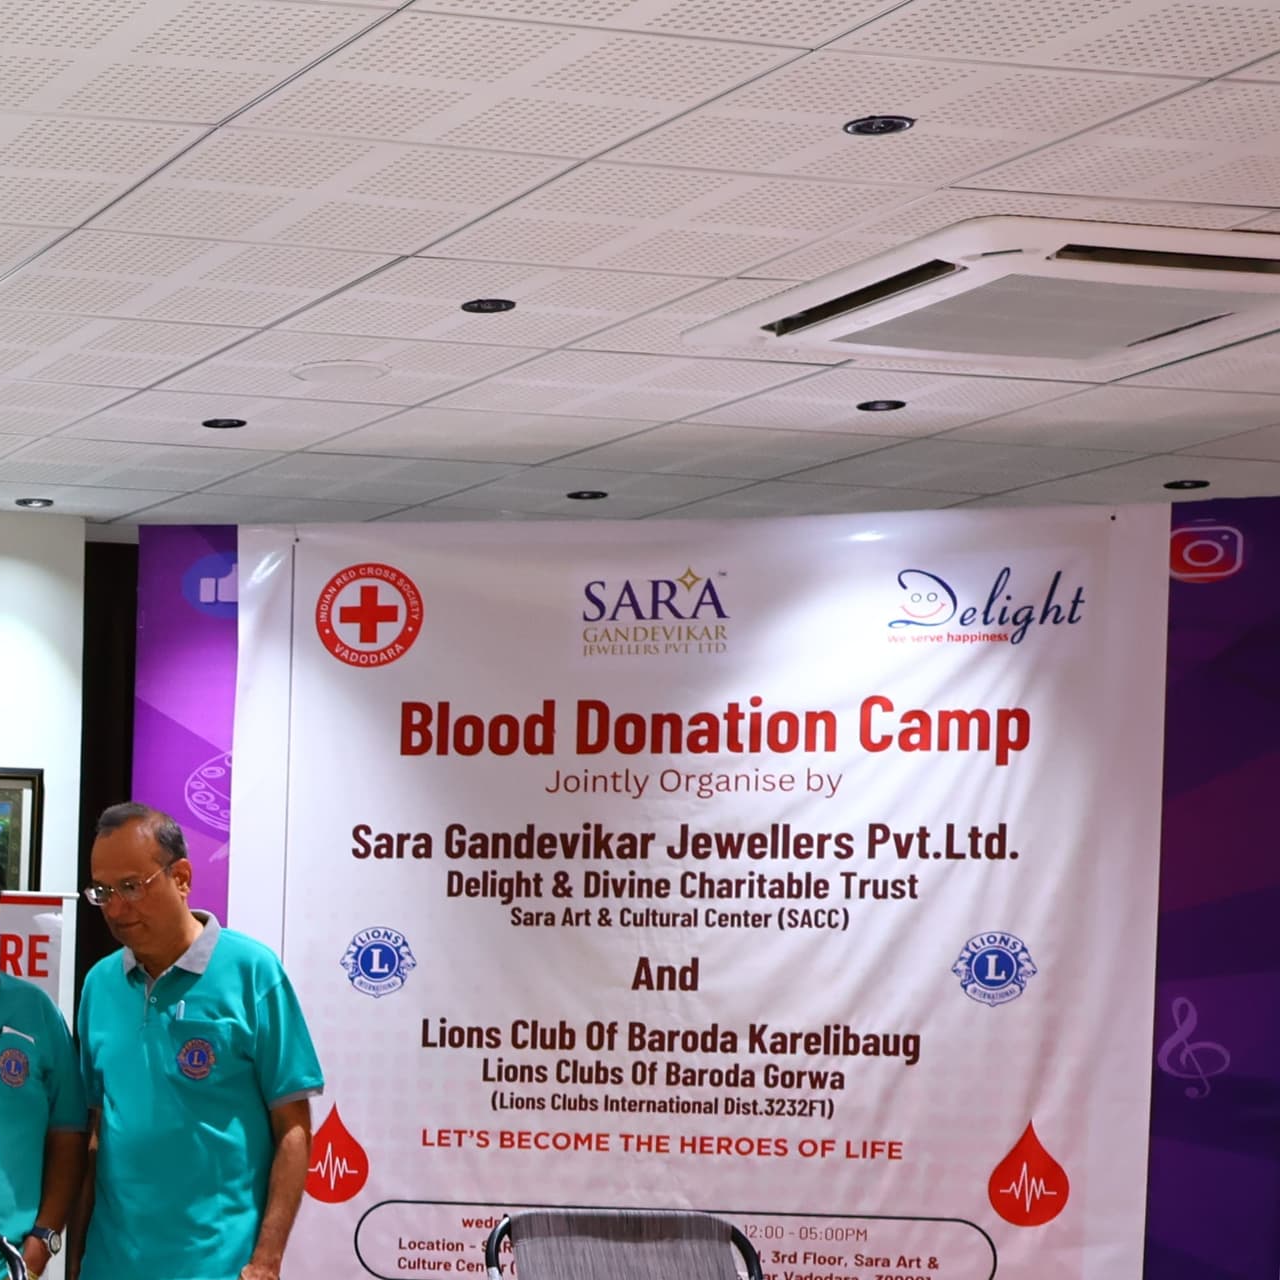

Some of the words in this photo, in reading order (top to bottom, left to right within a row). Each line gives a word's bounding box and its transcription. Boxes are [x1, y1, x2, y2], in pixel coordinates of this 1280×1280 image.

[320, 586, 337, 622] INDIAN
[335, 569, 356, 587] RED
[359, 566, 397, 581] CROSS
[396, 578, 420, 620] SOCIETY
[582, 577, 732, 622] SARA
[887, 566, 1086, 645] Delight
[582, 624, 728, 643] GANDEVIKAR
[911, 634, 943, 643] serve
[946, 631, 1009, 645] happiness
[334, 643, 404, 664] VADODARA
[583, 643, 659, 657] JEWELLERS
[400, 699, 556, 756] Blood
[576, 696, 837, 755] Donation
[858, 695, 1031, 766] Camp
[545, 768, 650, 799] Jointly
[659, 768, 795, 799] Organise
[806, 767, 843, 798] by
[351, 824, 433, 860] Sara
[444, 823, 656, 860] Gandevikar
[666, 823, 854, 860] Jewellers
[867, 823, 1019, 860] Pvt.Ltd.
[446, 870, 543, 905] Delight
[551, 871, 573, 899] &
[583, 870, 671, 899] Divine
[680, 871, 830, 900] Charitable
[840, 872, 919, 900] Trust
[511, 906, 556, 927] Sara
[561, 907, 592, 927] Art
[597, 908, 612, 927] &
[619, 907, 698, 928] Cultural
[704, 908, 772, 928] Center
[777, 907, 850, 930] (SACC)
[358, 930, 401, 944] LIONS
[971, 935, 1019, 950] LIONS
[370, 948, 389, 973] L
[631, 956, 699, 991] And
[985, 954, 1006, 980] L
[421, 1017, 501, 1049] Lions
[511, 1019, 576, 1050] Club
[586, 1020, 618, 1051] Of
[628, 1021, 738, 1055] Baroda
[748, 1023, 921, 1065] Karelibaug
[482, 1058, 548, 1083] Lions
[555, 1059, 623, 1085] Clubs
[631, 1060, 657, 1086] Of
[666, 1062, 755, 1088] Baroda
[763, 1064, 845, 1090] Gorwa
[491, 1090, 545, 1111] (Lions
[551, 1093, 598, 1112] Clubs
[604, 1093, 718, 1116] International
[724, 1097, 835, 1120] Dist.3232F1)
[421, 1128, 490, 1148] LET'S
[499, 1130, 610, 1152] BECOME
[620, 1133, 670, 1153] THE
[679, 1135, 788, 1157] HEROES
[798, 1138, 836, 1158] OF
[845, 1140, 903, 1160] LIFE
[398, 1237, 464, 1252] Location
[744, 1224, 784, 1239] 12:00
[799, 1225, 868, 1242] 05:00PM
[398, 1257, 451, 1271] Culture
[455, 1259, 507, 1272] Cenr
[771, 1250, 798, 1264] 3rd
[803, 1251, 848, 1267] Floor,
[854, 1253, 890, 1269] Sara
[896, 1255, 922, 1269] Art
[927, 1256, 939, 1270] &
